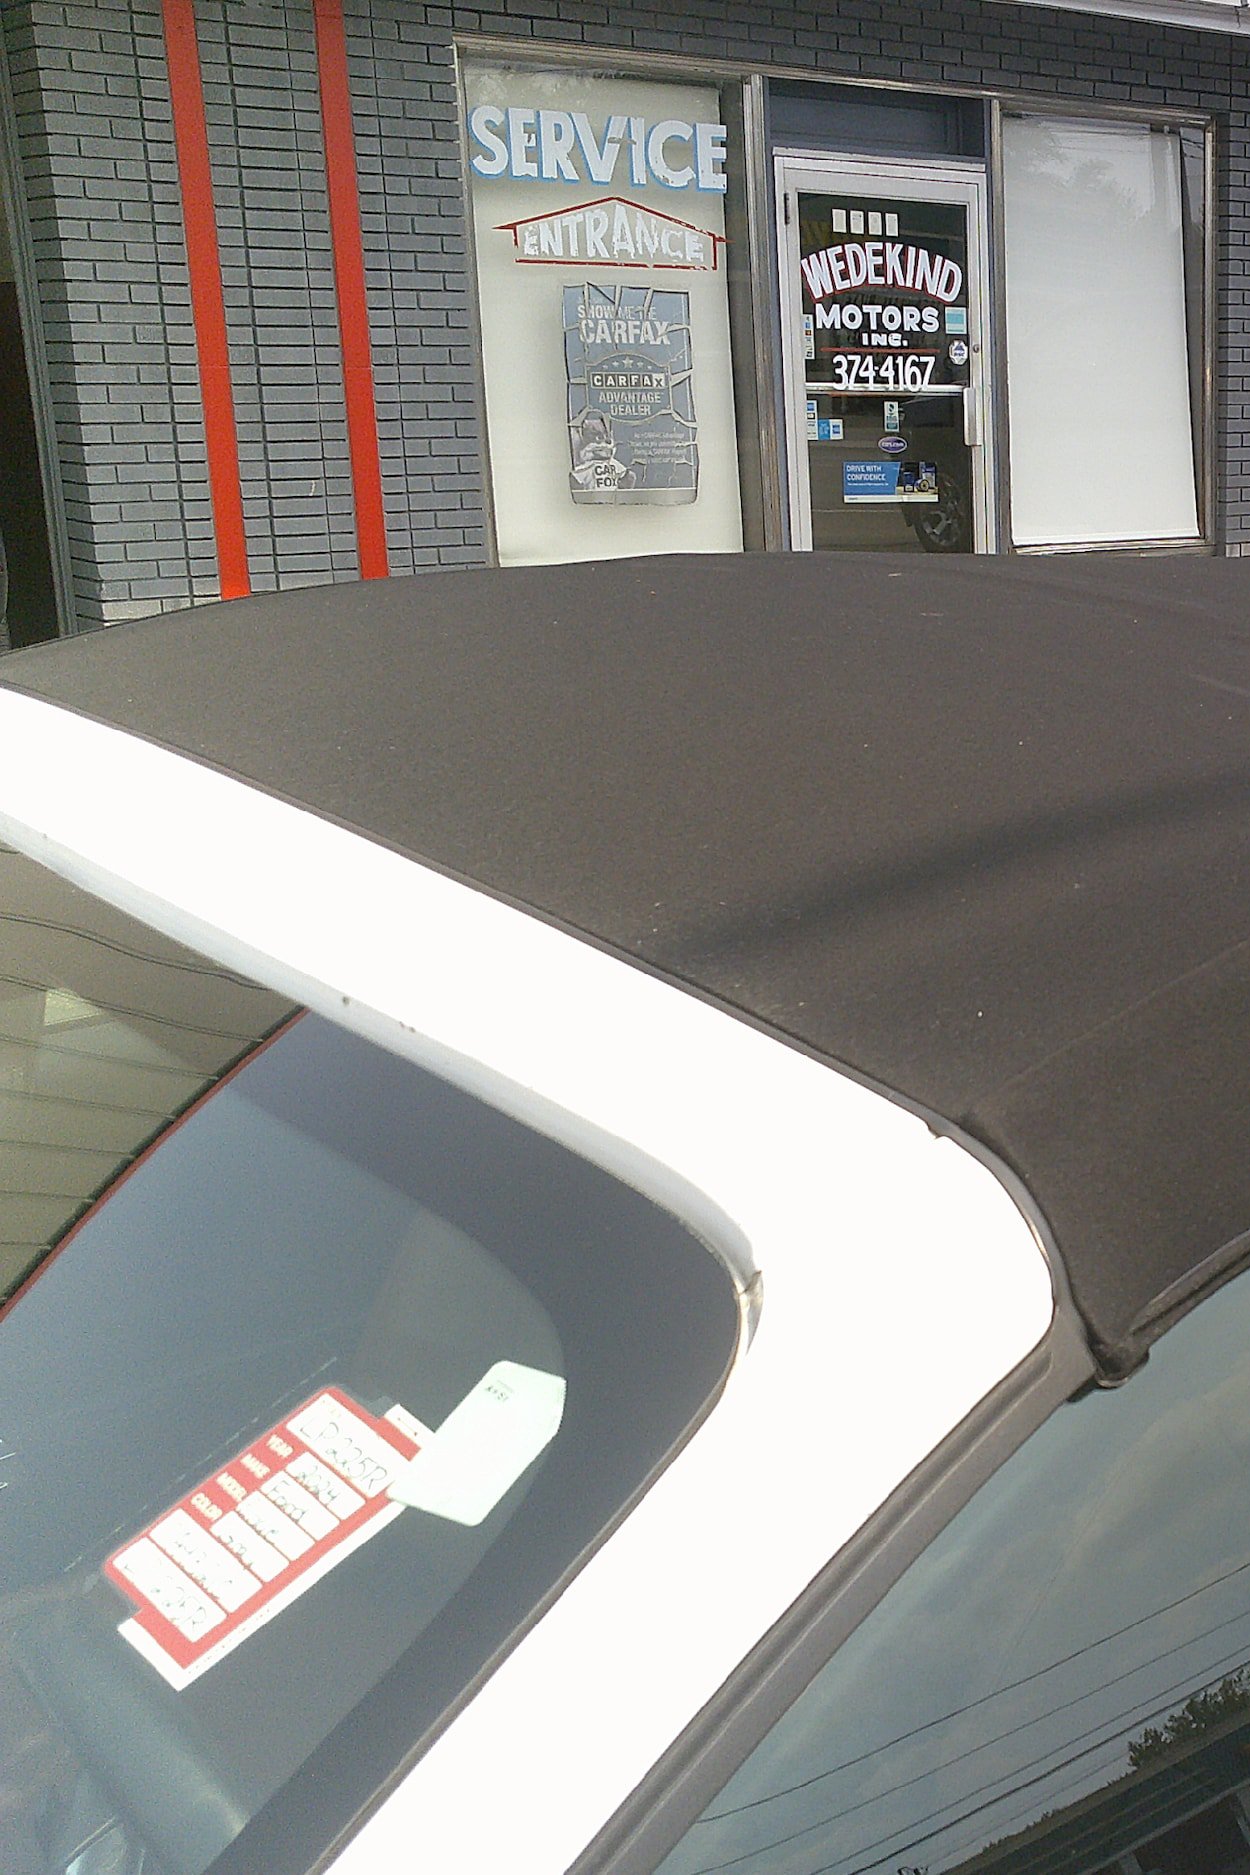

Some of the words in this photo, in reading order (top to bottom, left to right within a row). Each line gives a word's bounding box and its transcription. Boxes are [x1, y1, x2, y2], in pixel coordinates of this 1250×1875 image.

[468, 105, 727, 193] SERVICE
[523, 204, 704, 262] ENTRANCE
[801, 241, 963, 304] WEDEKIND
[815, 303, 940, 332] MOTORS
[579, 320, 671, 345] CARFAX
[861, 333, 909, 347] INC.
[593, 374, 665, 388] CARFAX
[832, 354, 936, 391] 374-4167
[599, 391, 662, 404] ADVANTAGE
[610, 404, 652, 416] DEALER
[594, 464, 617, 476] CAR
[595, 477, 619, 488] FOX
